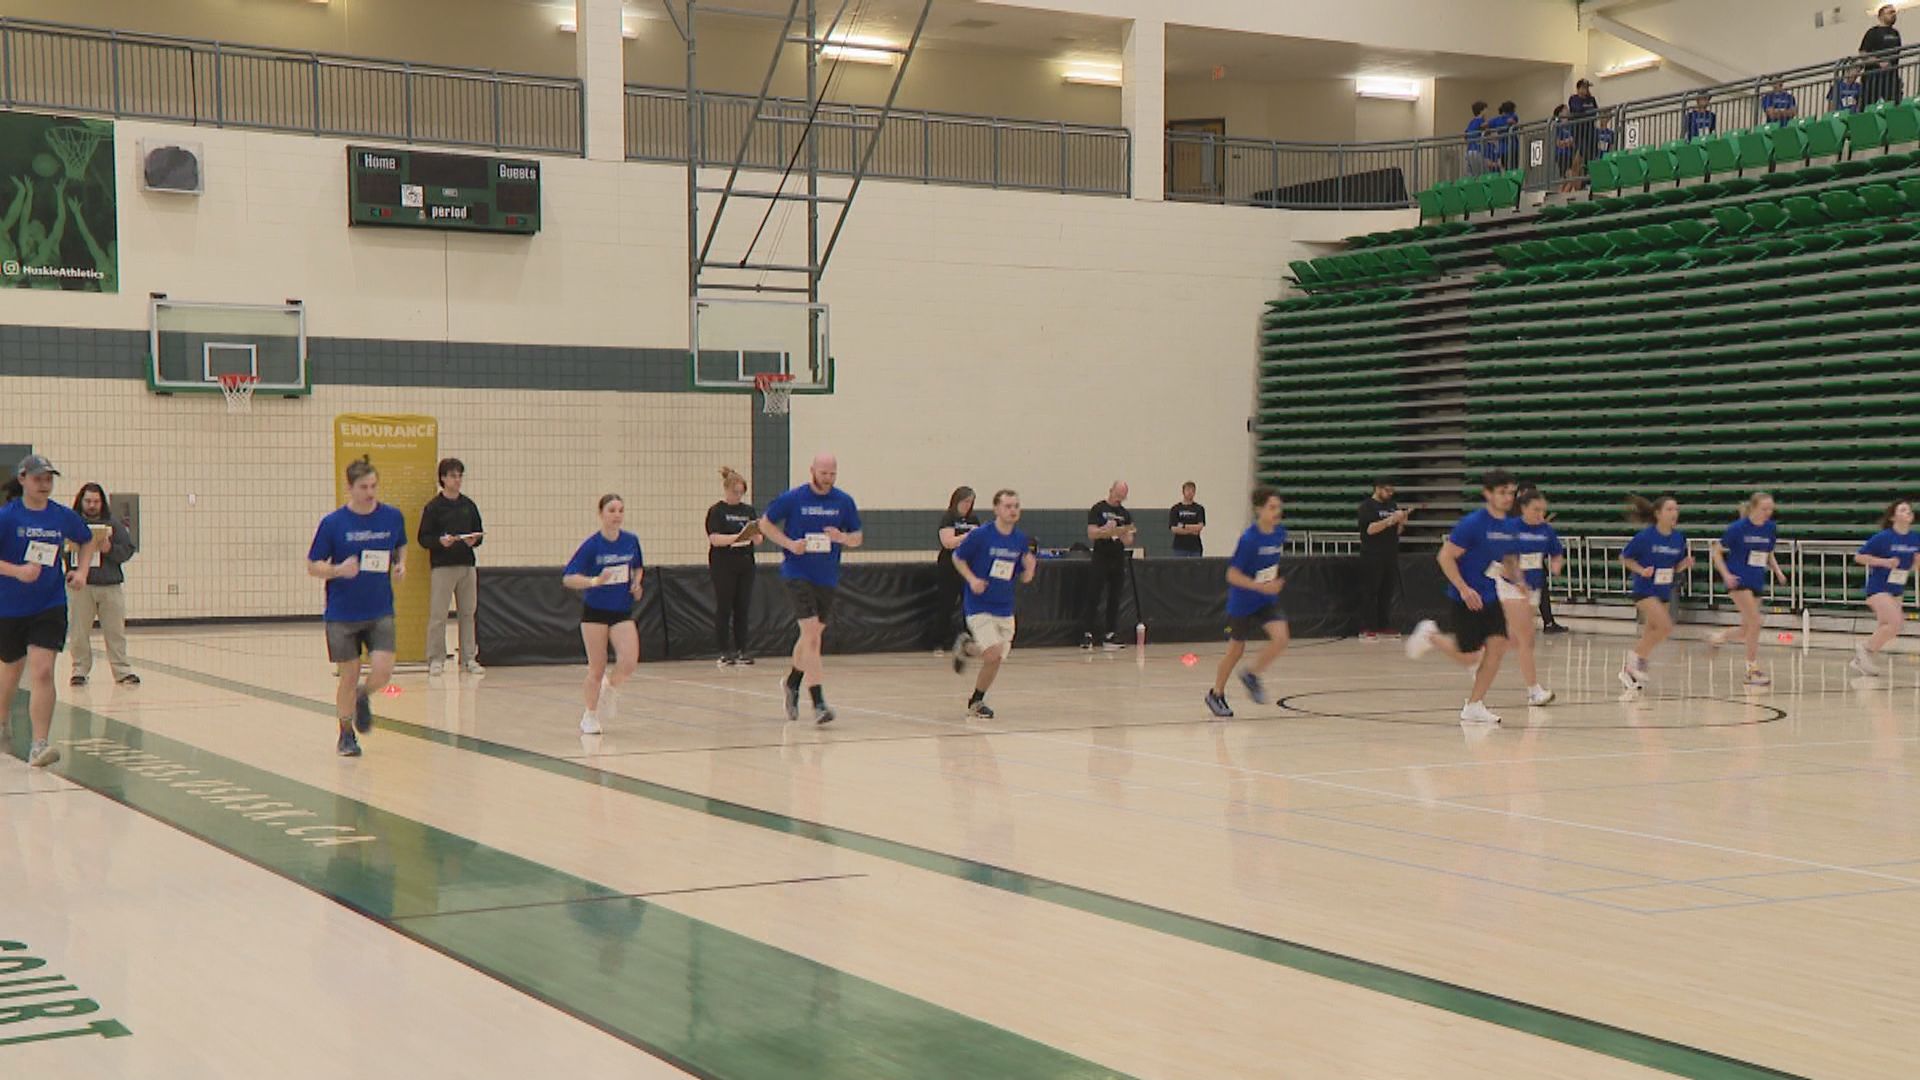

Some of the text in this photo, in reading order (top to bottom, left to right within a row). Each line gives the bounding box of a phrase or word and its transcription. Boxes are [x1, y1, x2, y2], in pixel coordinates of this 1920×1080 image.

[1628, 128, 1637, 143] 9
[1532, 145, 1541, 161] 10
[364, 154, 396, 169] Home
[499, 164, 536, 180] Guests
[432, 206, 467, 219] period
[23, 266, 104, 279] HuskieAthletics
[340, 423, 436, 437] ENDURANCE
[0, 940, 133, 1046] URT
